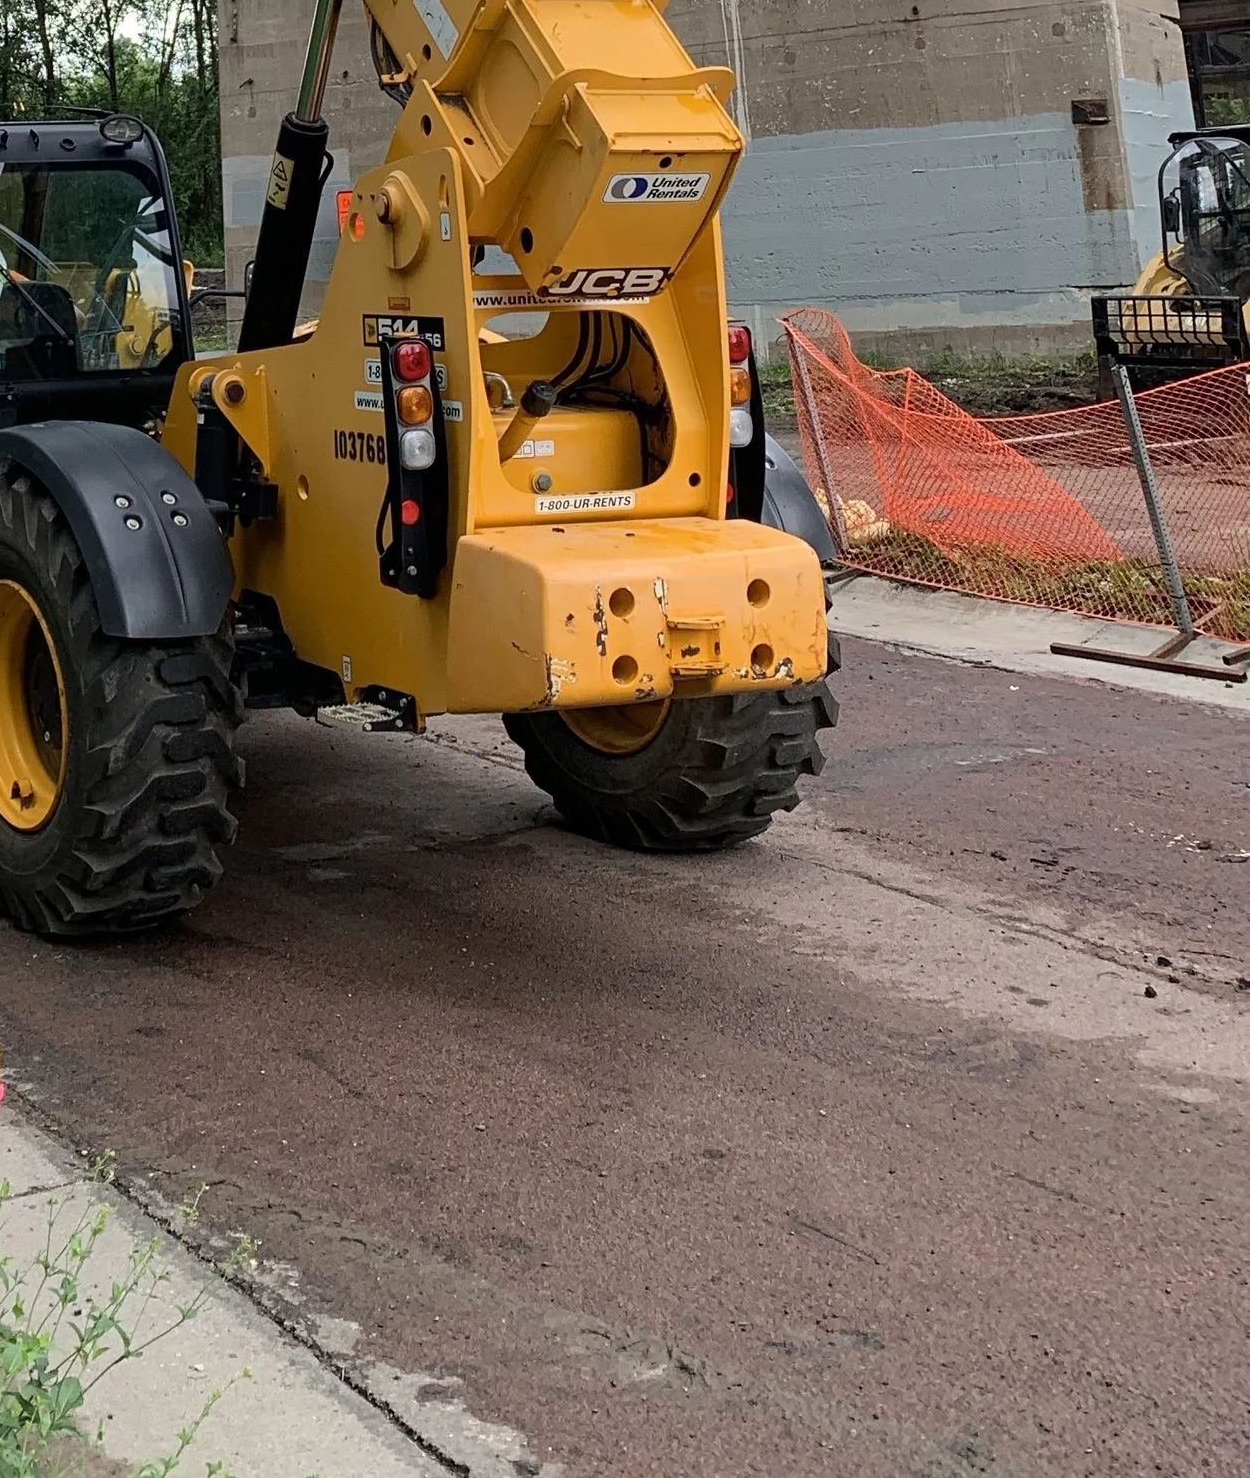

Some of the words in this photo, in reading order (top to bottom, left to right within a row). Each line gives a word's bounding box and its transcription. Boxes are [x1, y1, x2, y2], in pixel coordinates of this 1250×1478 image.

[652, 177, 701, 188] United
[647, 188, 699, 199] Rentals
[548, 269, 664, 294] JCB
[539, 496, 631, 511] 1-800-UR-RENTS
